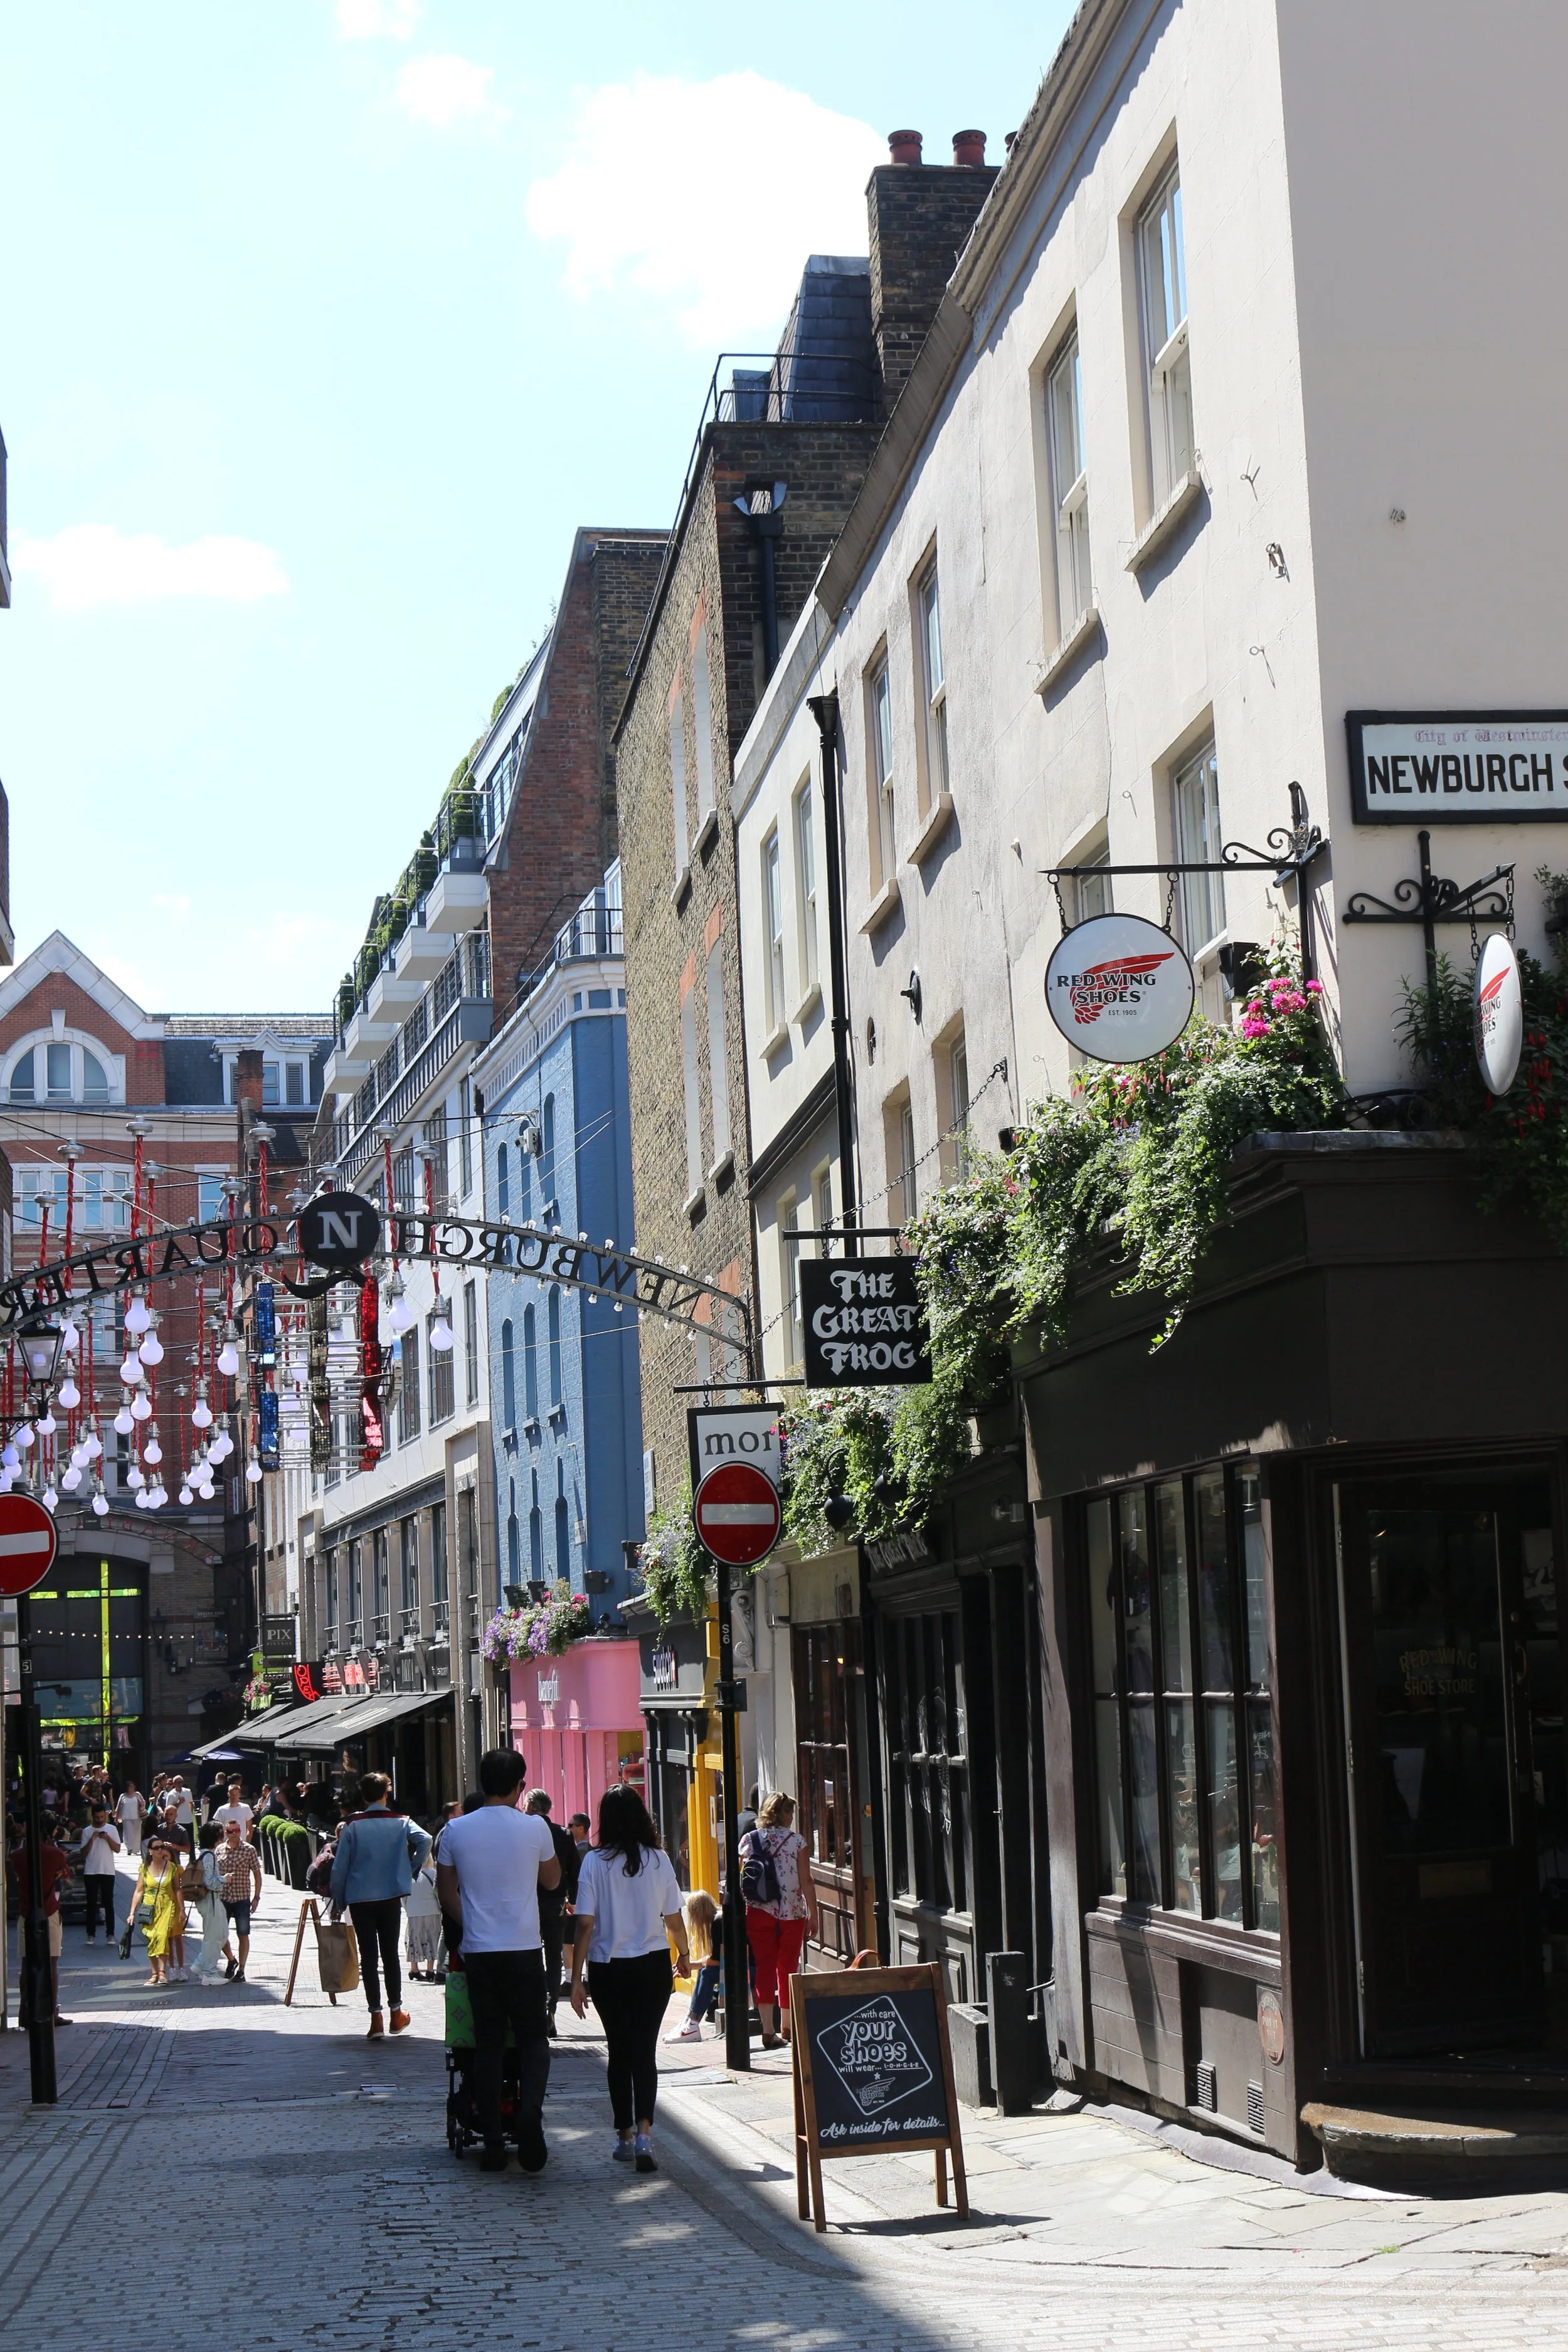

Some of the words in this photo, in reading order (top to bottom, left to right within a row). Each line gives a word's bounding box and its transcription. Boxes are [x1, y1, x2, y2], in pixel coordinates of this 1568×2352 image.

[1414, 729, 1447, 746] City
[1452, 729, 1470, 743] of
[1367, 753, 1554, 795] NEWBURGH
[1057, 974, 1096, 988] RED
[1101, 973, 1156, 986] WING
[1076, 990, 1141, 1003] SHOES
[1481, 995, 1501, 1016] WING
[317, 1210, 363, 1249] N
[830, 1270, 896, 1304] THE
[812, 1304, 919, 1338] GREAT
[820, 1341, 917, 1376] FROG
[267, 1628, 292, 1640] PIX
[1399, 1648, 1430, 1673] RED
[1438, 1646, 1478, 1670] WING
[1405, 1680, 1436, 1696] SHOE
[1438, 1678, 1476, 1695] STORE
[879, 2010, 896, 2019] care
[839, 2020, 896, 2047] your
[840, 2038, 908, 2065] shoes
[839, 2065, 853, 2073] will
[820, 2122, 847, 2138] Ask
[849, 2120, 882, 2134] inside
[881, 2117, 901, 2135] for
